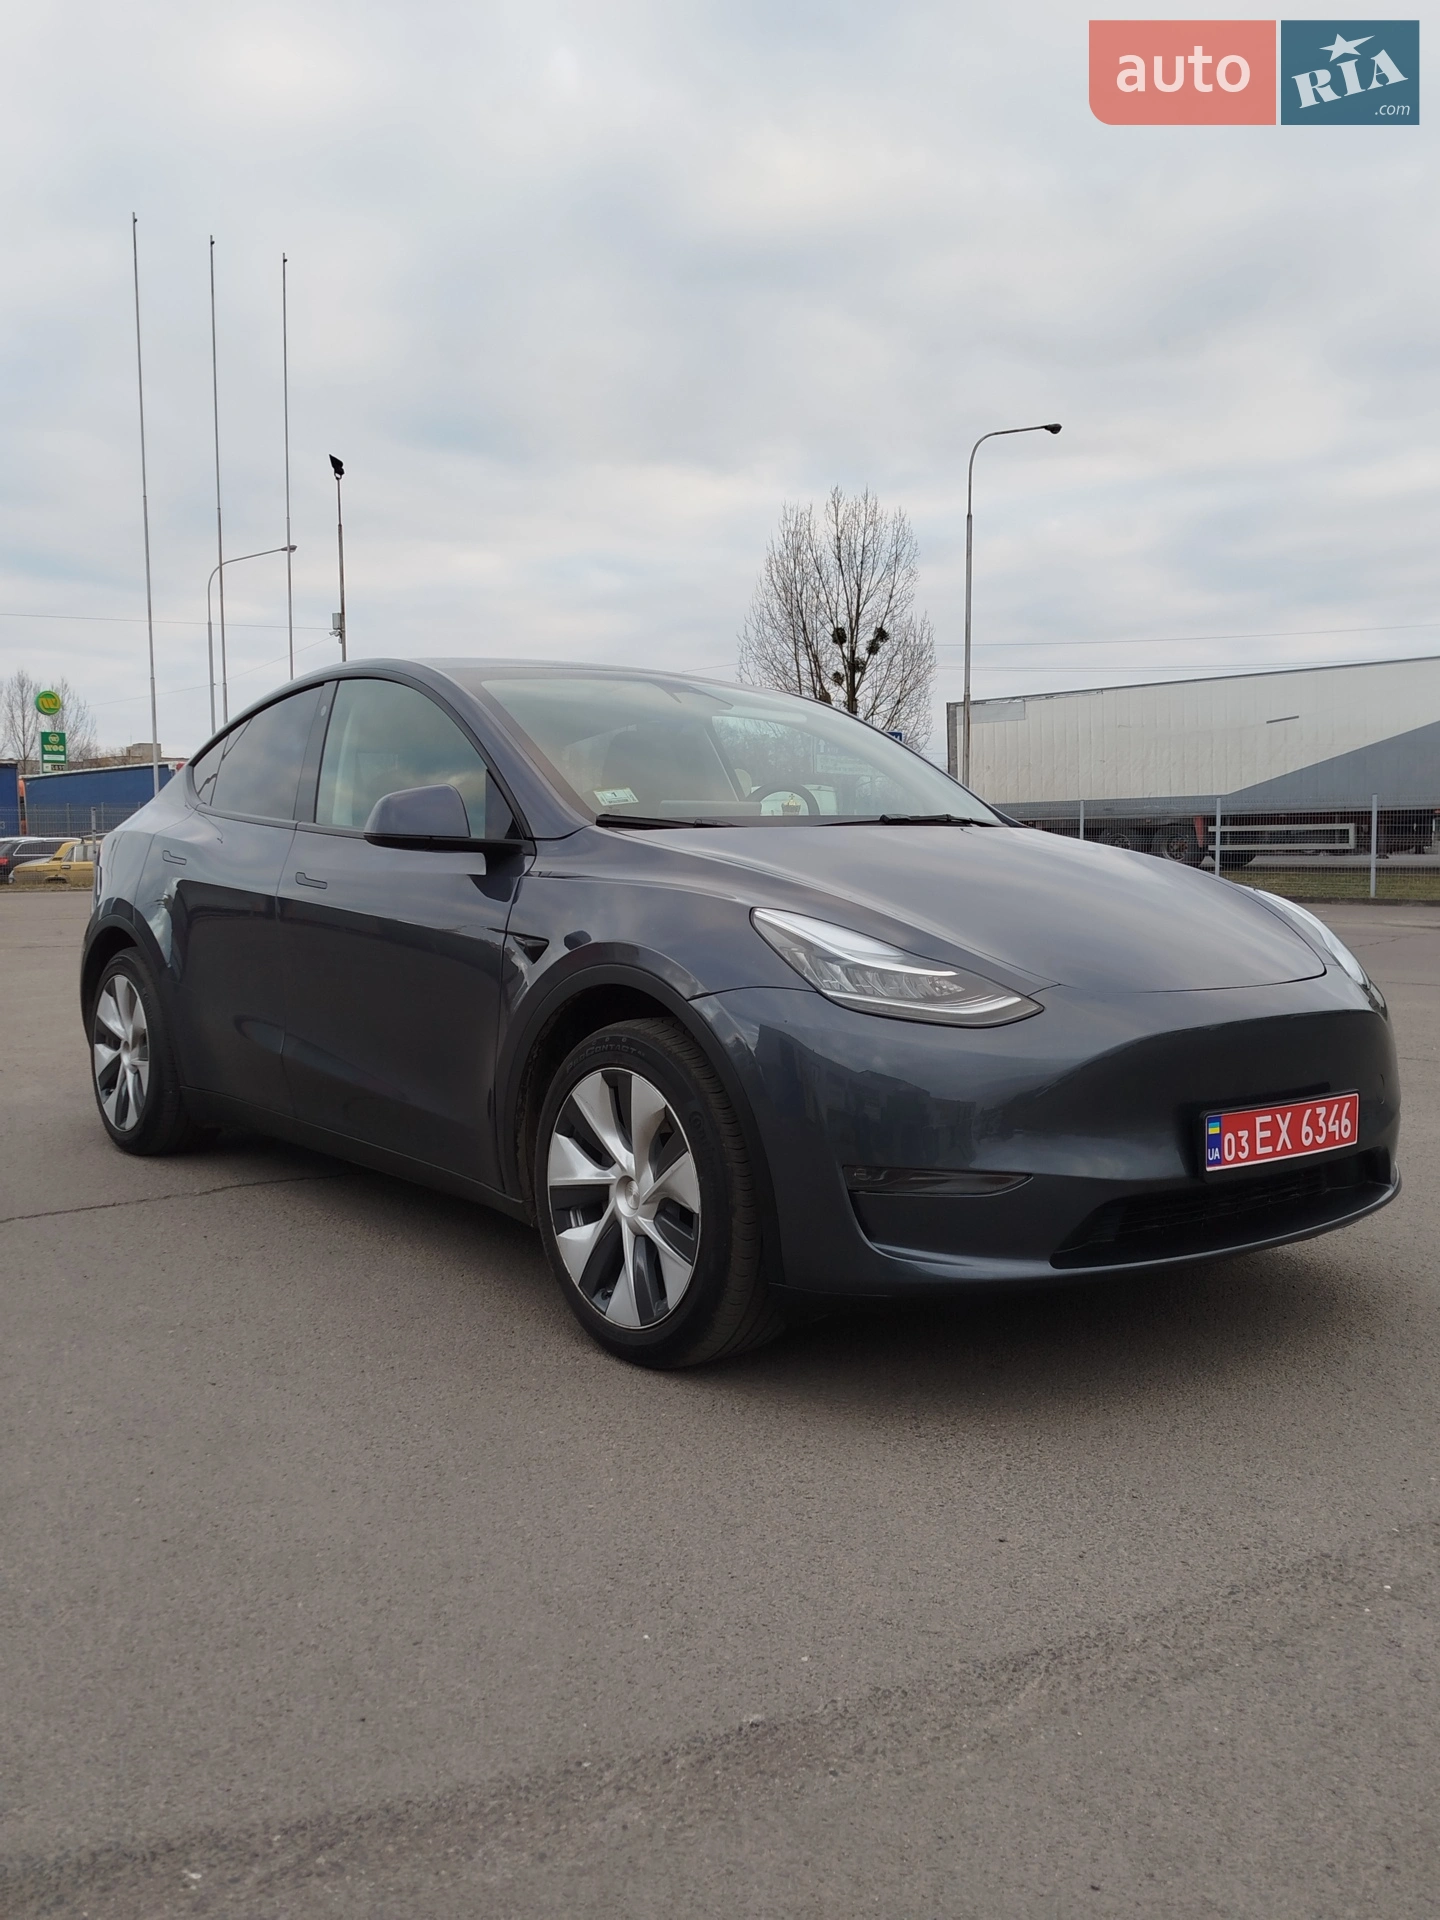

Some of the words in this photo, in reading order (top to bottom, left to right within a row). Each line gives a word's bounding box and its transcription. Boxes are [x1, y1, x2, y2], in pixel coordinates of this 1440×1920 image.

[43, 744, 65, 752] WOG
[1223, 1130, 1249, 1161] 03
[1255, 1112, 1292, 1155] EX
[1301, 1101, 1351, 1147] 6346
[1207, 1147, 1221, 1161] UA
